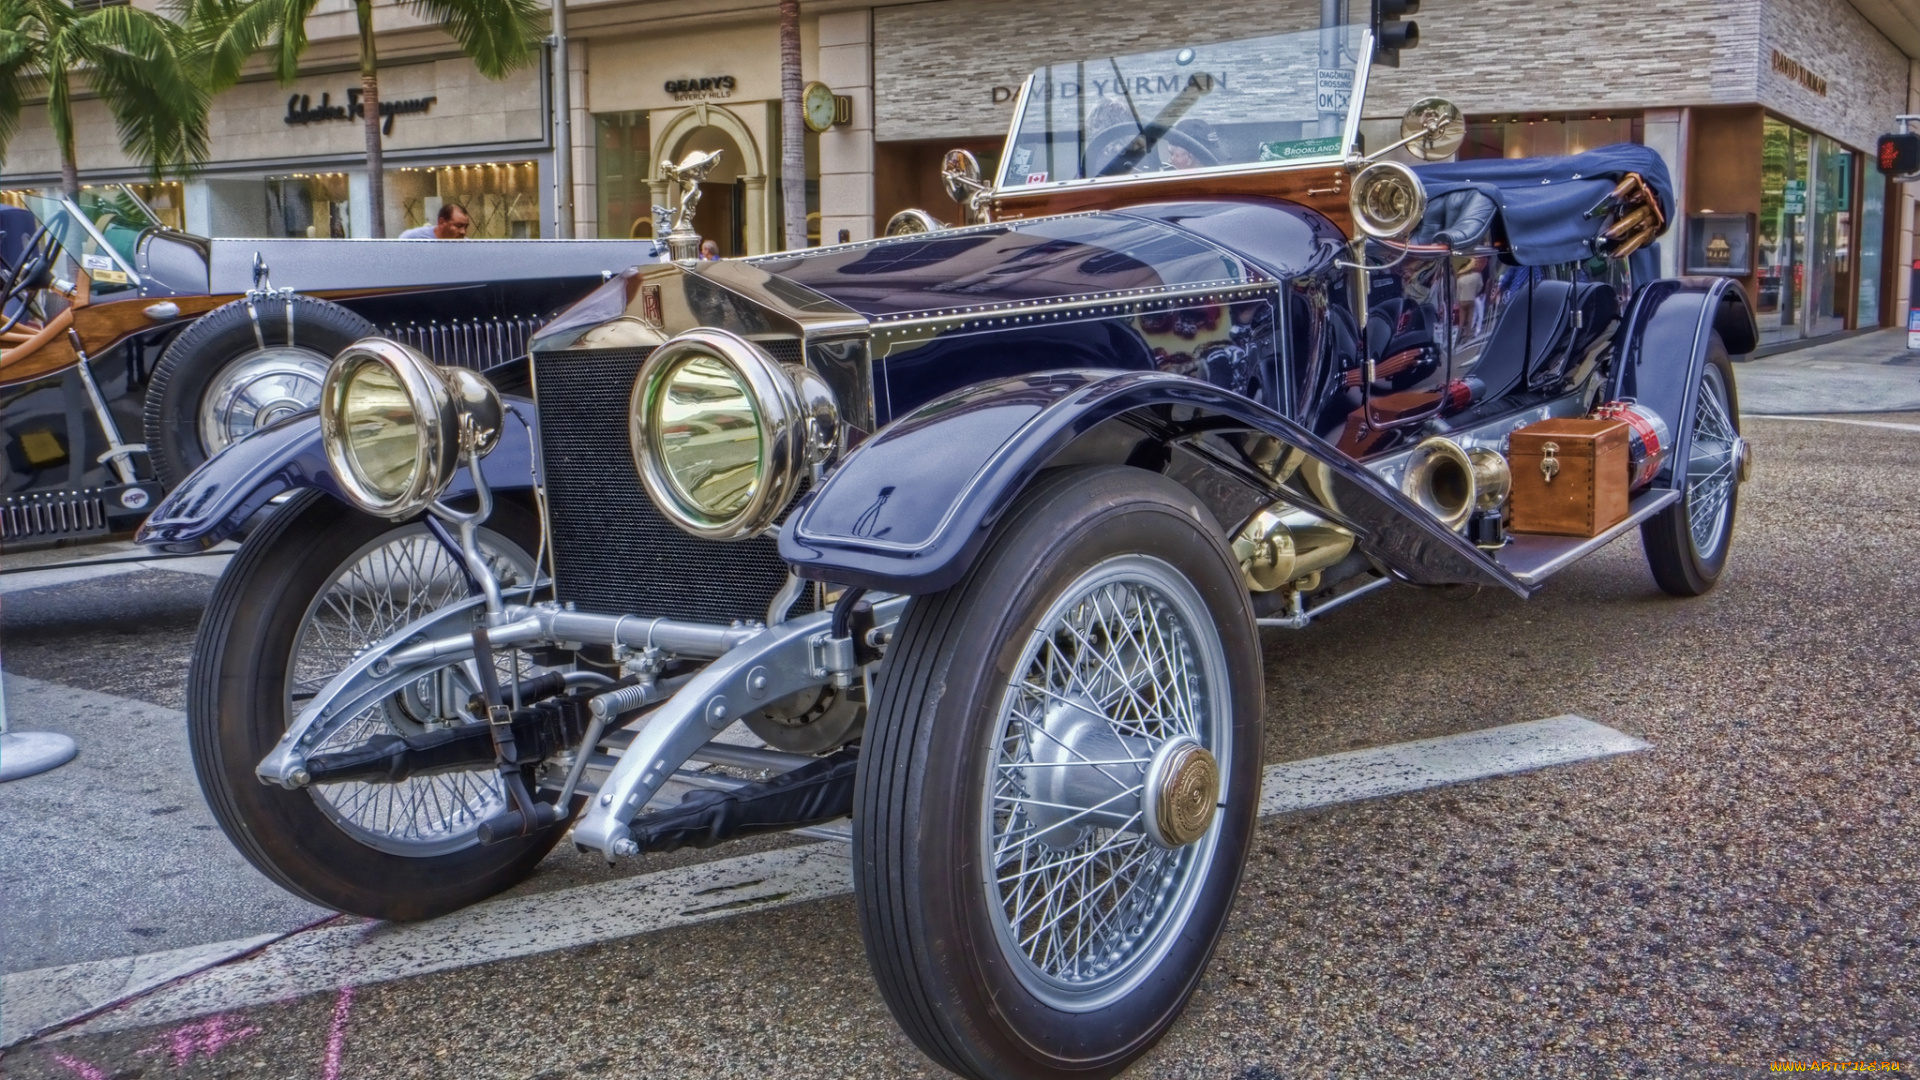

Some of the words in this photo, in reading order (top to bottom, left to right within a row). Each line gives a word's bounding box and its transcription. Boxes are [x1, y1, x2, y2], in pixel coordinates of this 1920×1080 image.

[1319, 71, 1352, 80] DIAGONAL
[664, 75, 736, 93] GEARYS
[1093, 71, 1227, 97] YURMAN
[1319, 80, 1352, 89] CROSSING
[674, 93, 707, 101] BEVERLY
[709, 91, 731, 99] HILLS
[1319, 93, 1334, 108] OK
[1284, 143, 1341, 156] BROOKLANDS
